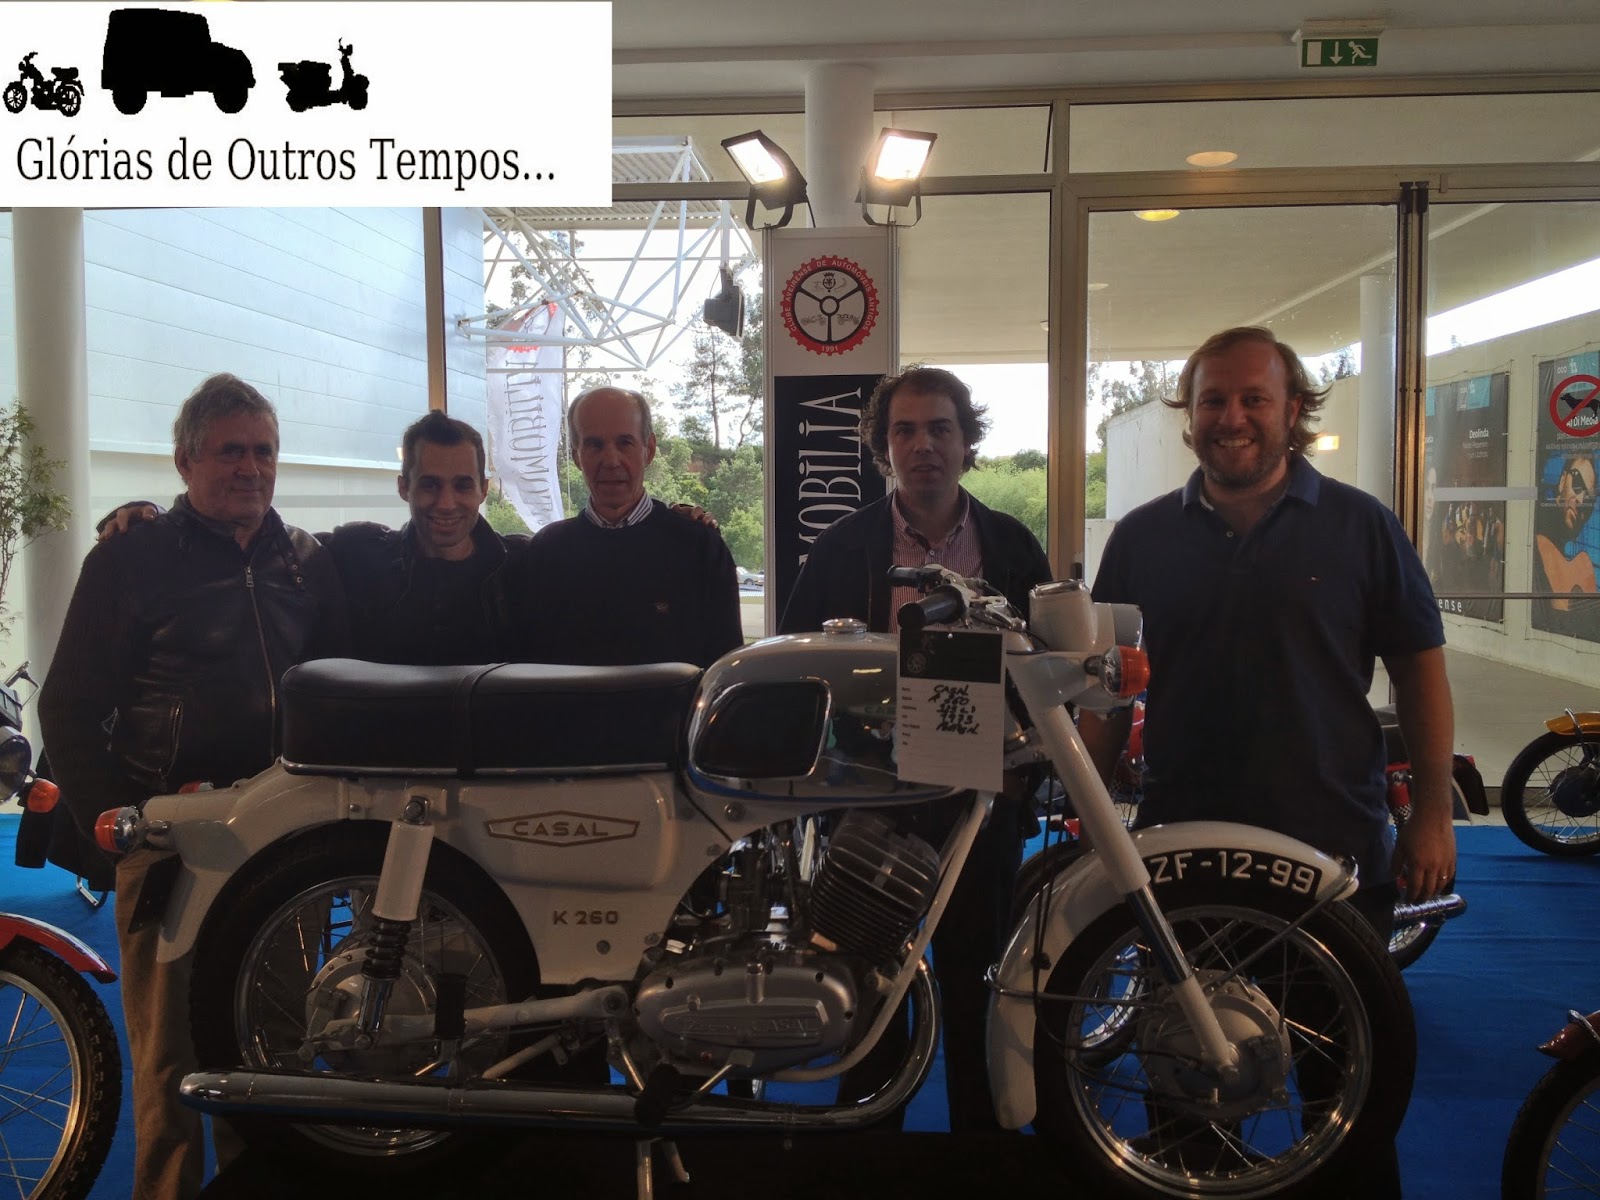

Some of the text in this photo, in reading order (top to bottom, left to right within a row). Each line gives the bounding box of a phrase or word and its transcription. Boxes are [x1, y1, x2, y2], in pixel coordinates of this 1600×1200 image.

[786, 266, 812, 302] AVEIRENSE
[785, 306, 796, 332] CLUBE
[863, 296, 875, 331] ANTIGOS
[512, 821, 608, 837] CASAL
[553, 910, 619, 925] K 260
